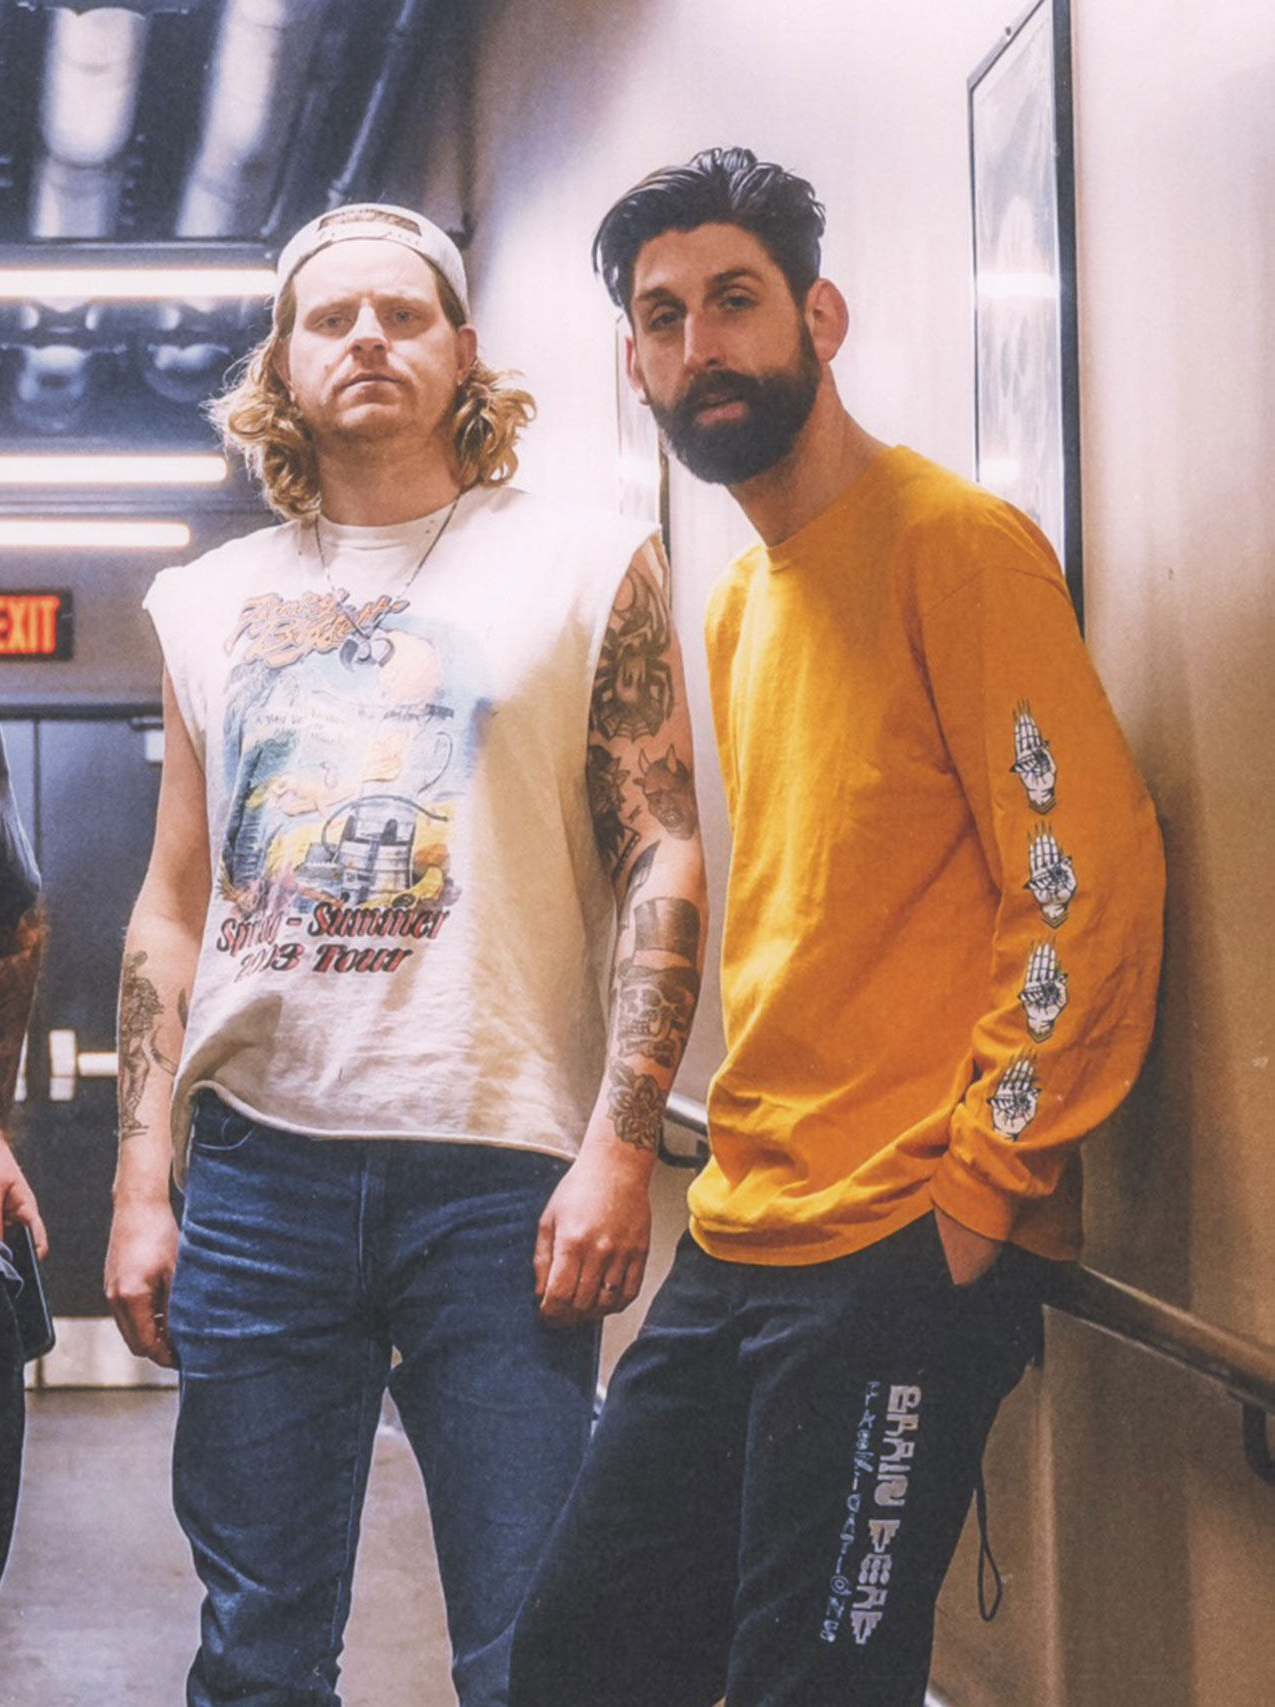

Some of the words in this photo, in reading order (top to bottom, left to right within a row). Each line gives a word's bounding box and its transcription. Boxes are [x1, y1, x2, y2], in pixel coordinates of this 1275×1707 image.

[307, 902, 450, 939] Summer
[312, 944, 413, 973] Tour
[873, 1384, 922, 1506] BRAIN
